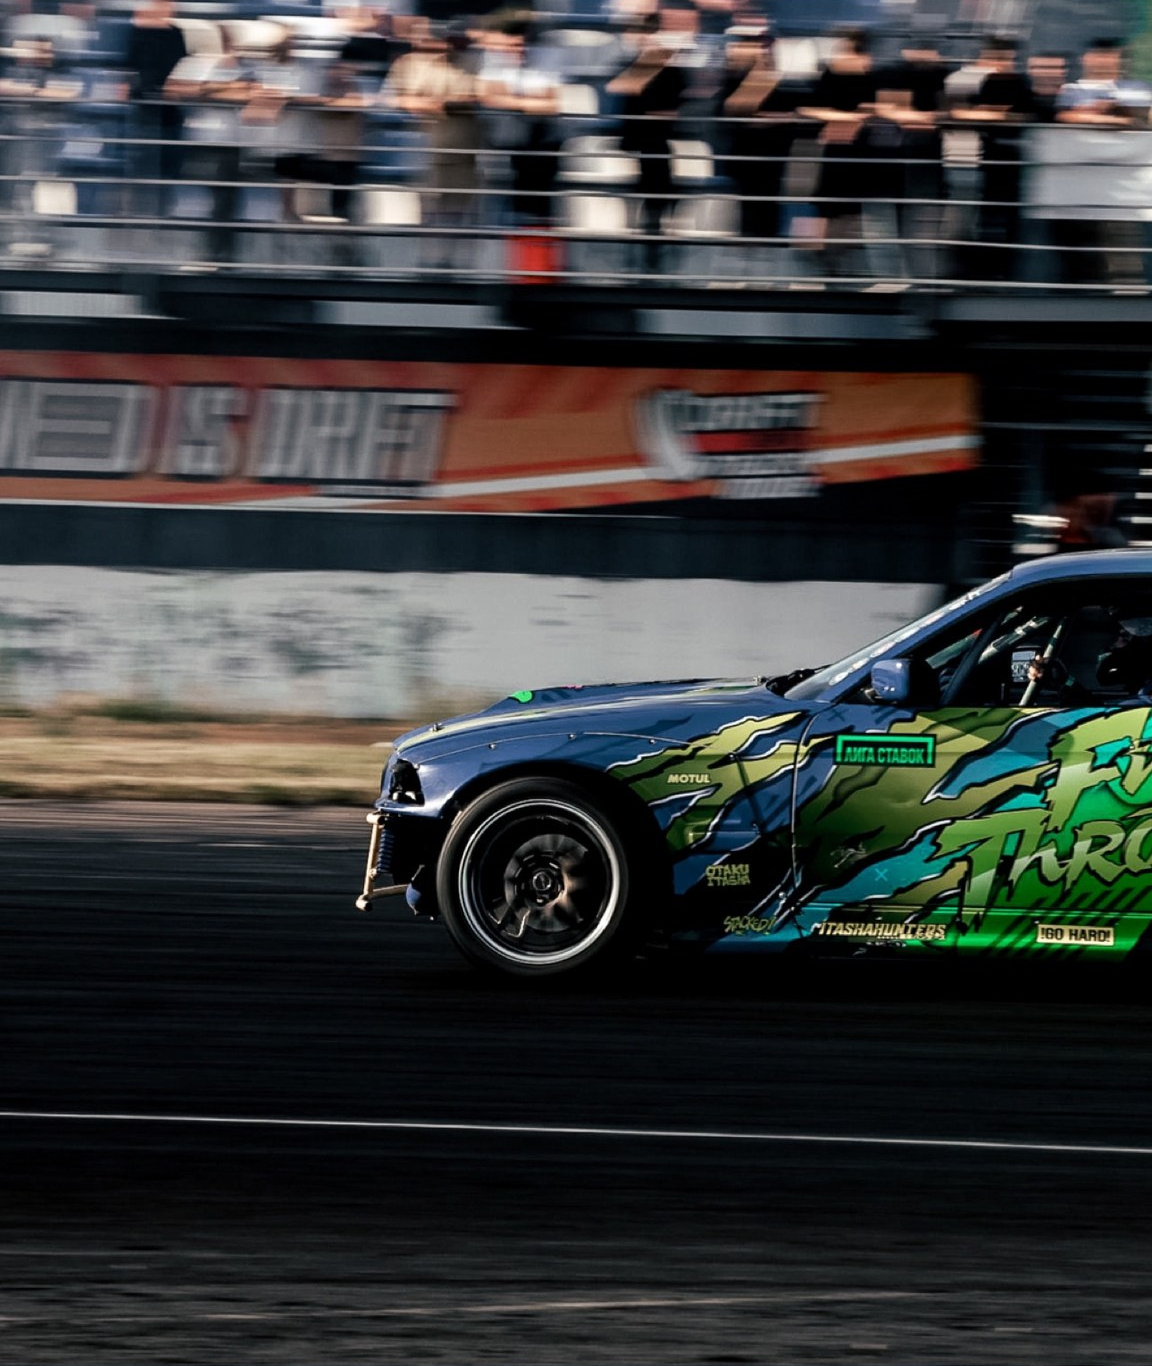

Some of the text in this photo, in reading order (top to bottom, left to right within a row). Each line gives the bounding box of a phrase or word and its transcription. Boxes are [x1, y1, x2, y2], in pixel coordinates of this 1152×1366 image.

[844, 746, 924, 764] ЛИГА СТАВОК
[667, 773, 711, 784] MOTUL
[705, 864, 750, 876] OTAKU
[1068, 928, 1111, 943] HARD!
